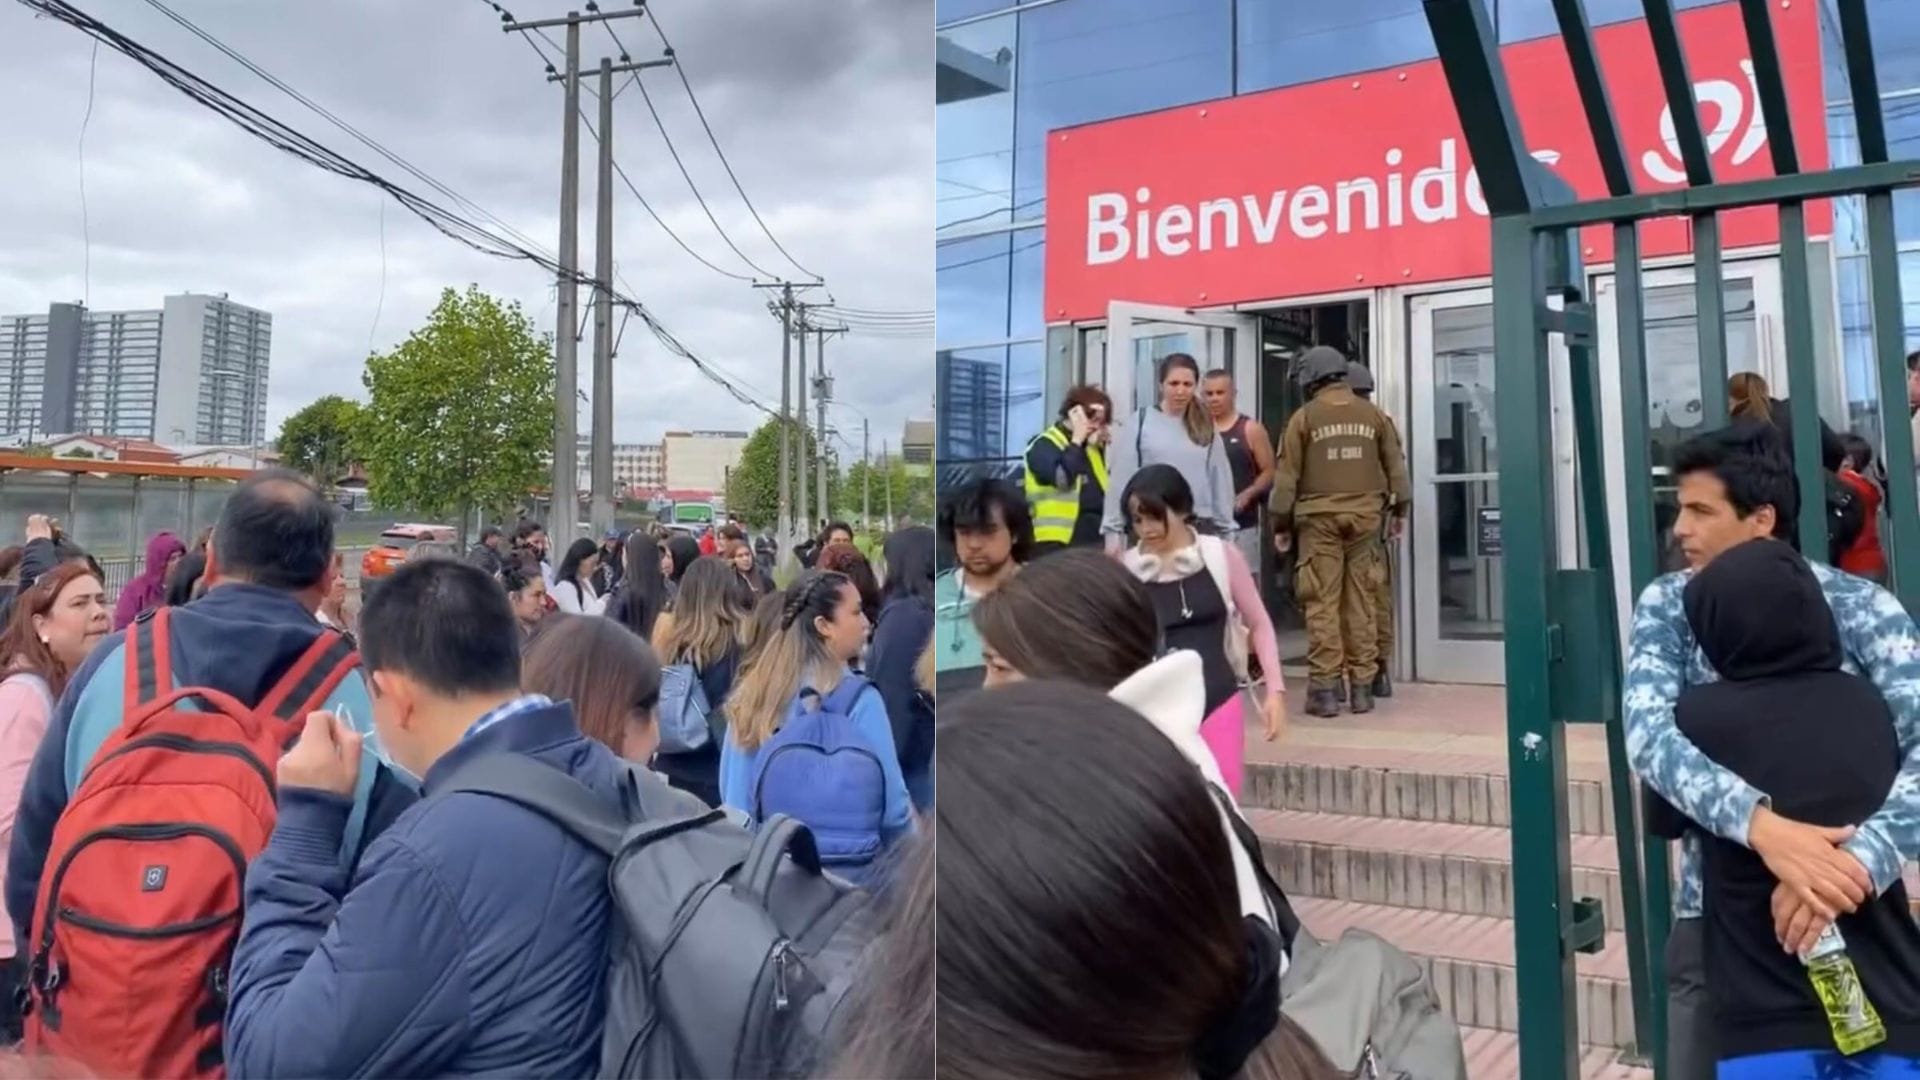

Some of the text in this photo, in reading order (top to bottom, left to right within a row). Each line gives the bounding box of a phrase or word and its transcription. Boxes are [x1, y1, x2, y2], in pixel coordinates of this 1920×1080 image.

[1086, 138, 1561, 266] Bienvenid
[1310, 423, 1376, 442] CARABINEROS
[1327, 446, 1363, 460] DE CHILE
